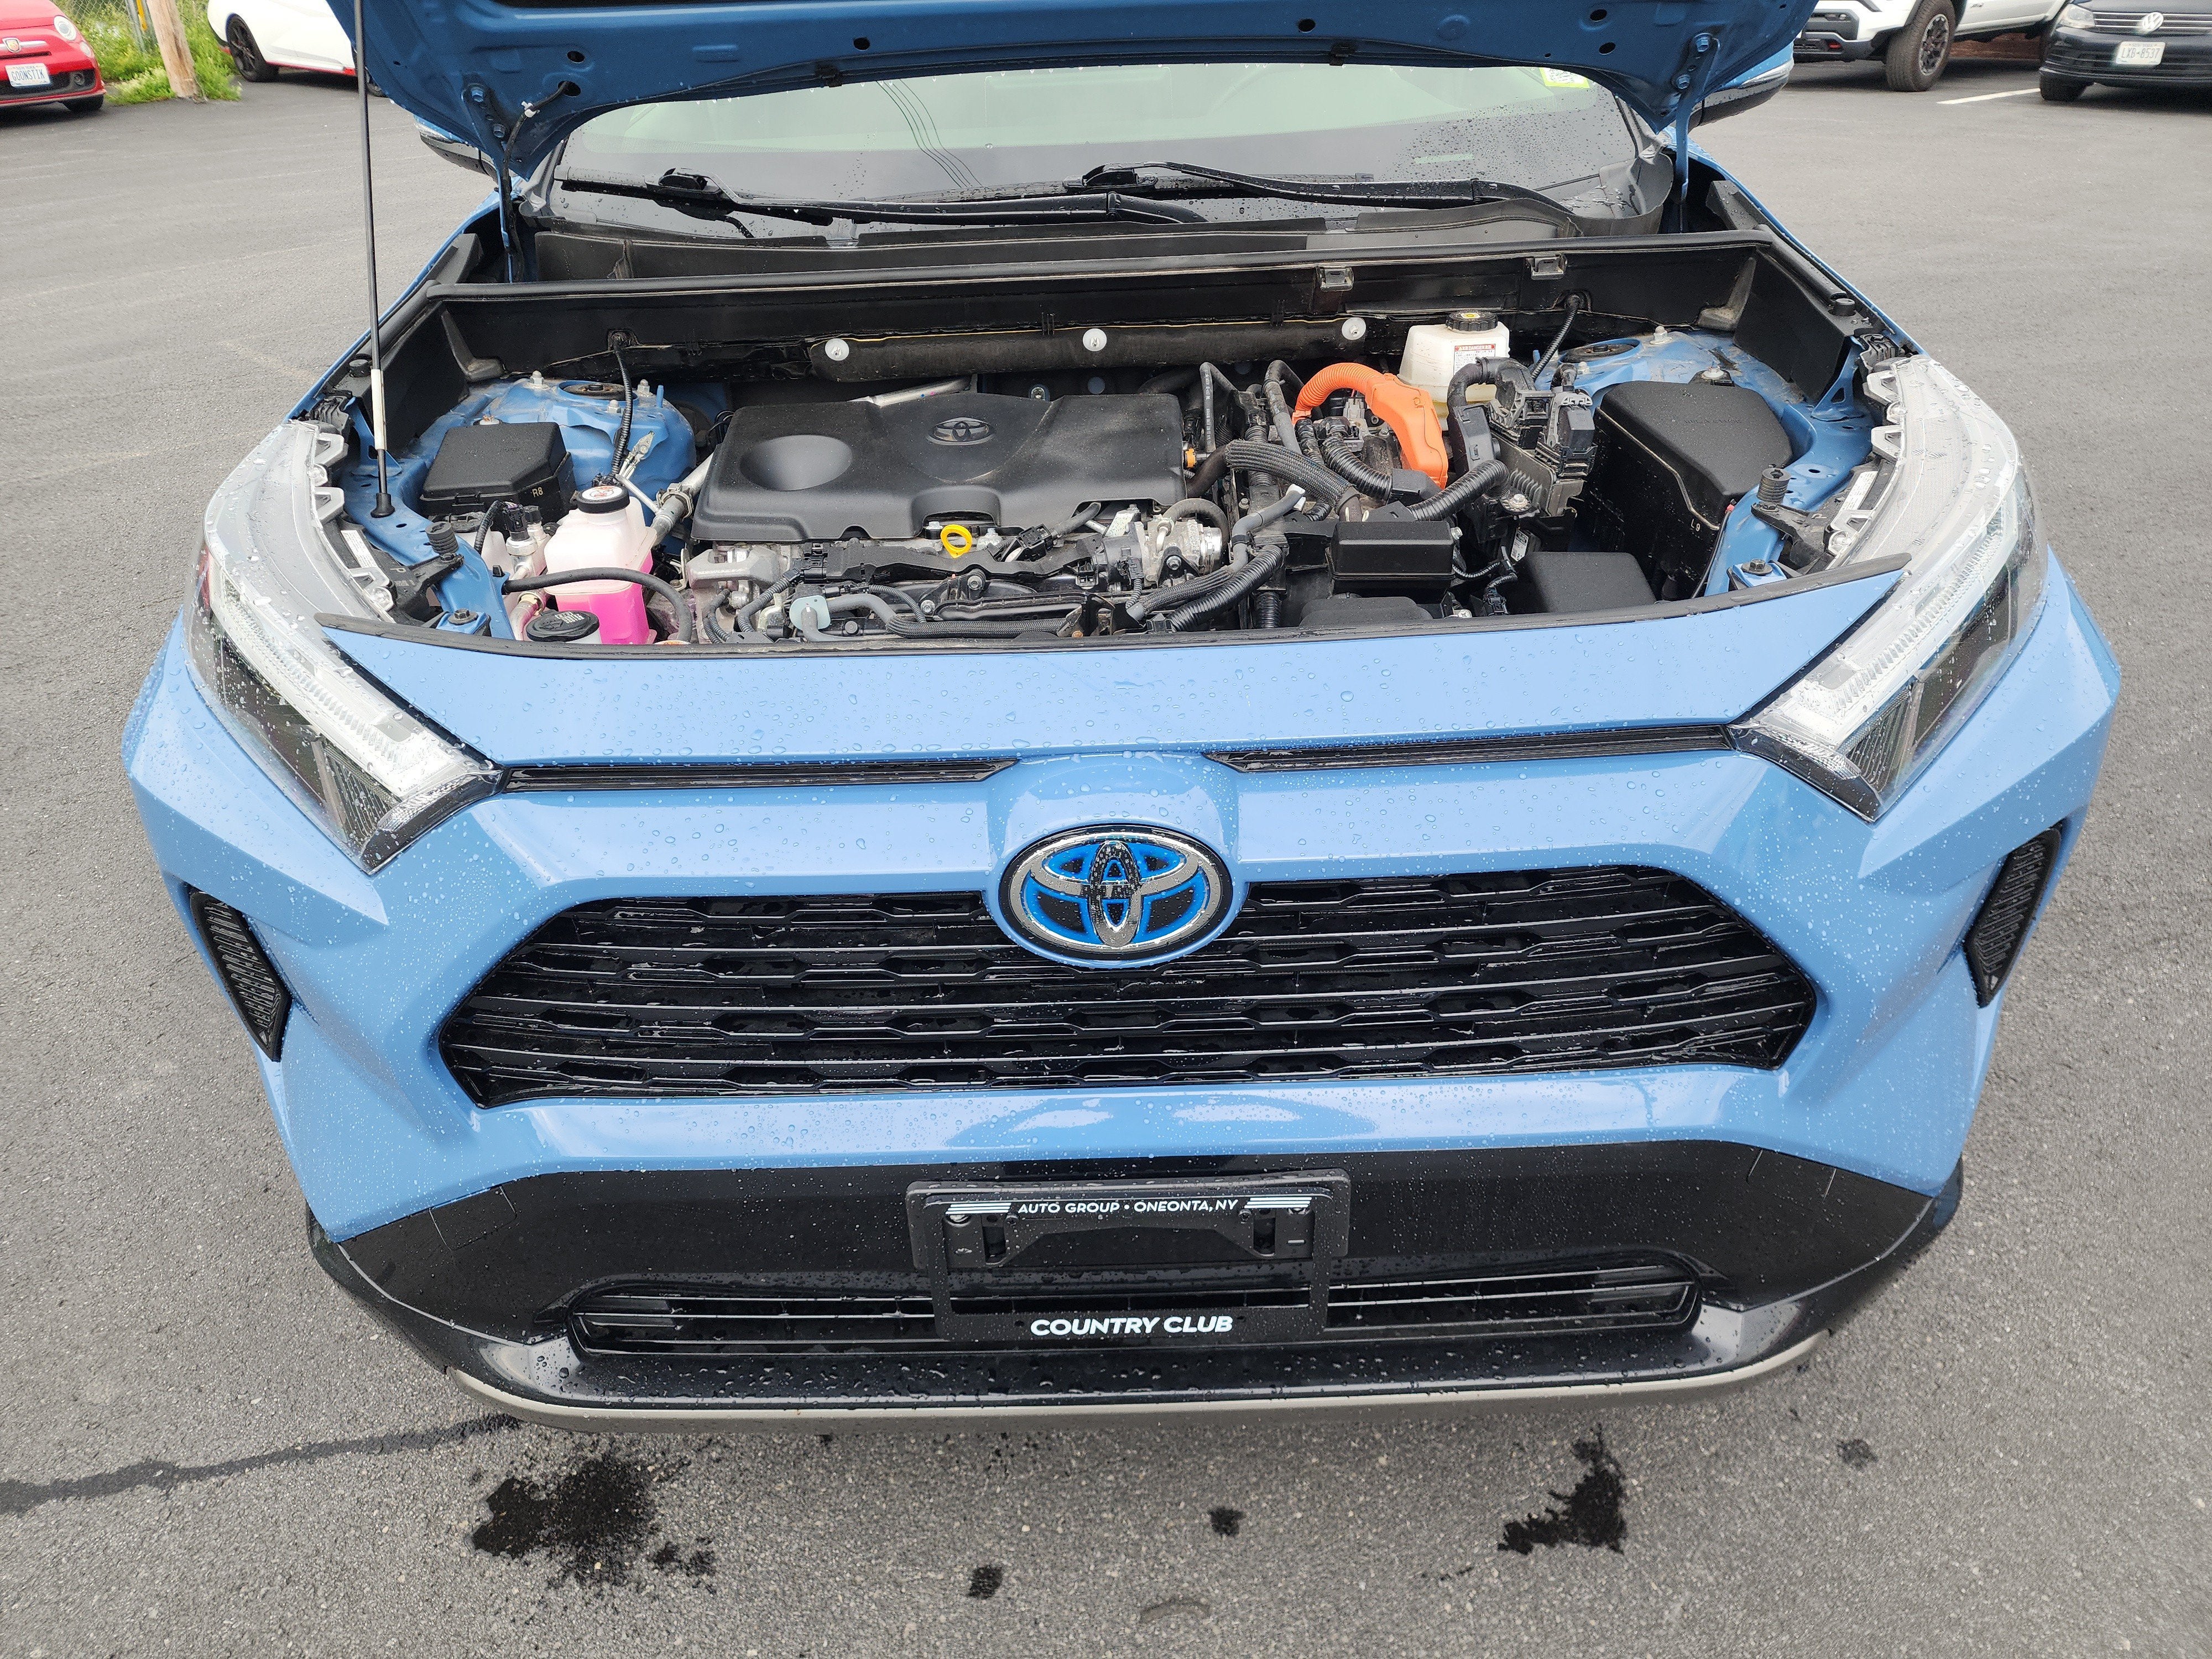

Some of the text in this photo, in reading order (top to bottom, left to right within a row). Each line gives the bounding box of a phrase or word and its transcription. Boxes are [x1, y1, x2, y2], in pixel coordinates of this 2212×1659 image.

[532, 487, 544, 497] R8
[1691, 518, 1700, 531] L9
[1018, 1203, 1061, 1214] AUTO
[1065, 1202, 1120, 1213] GROUP
[1030, 1316, 1233, 1336] COUNTRY CLUB
